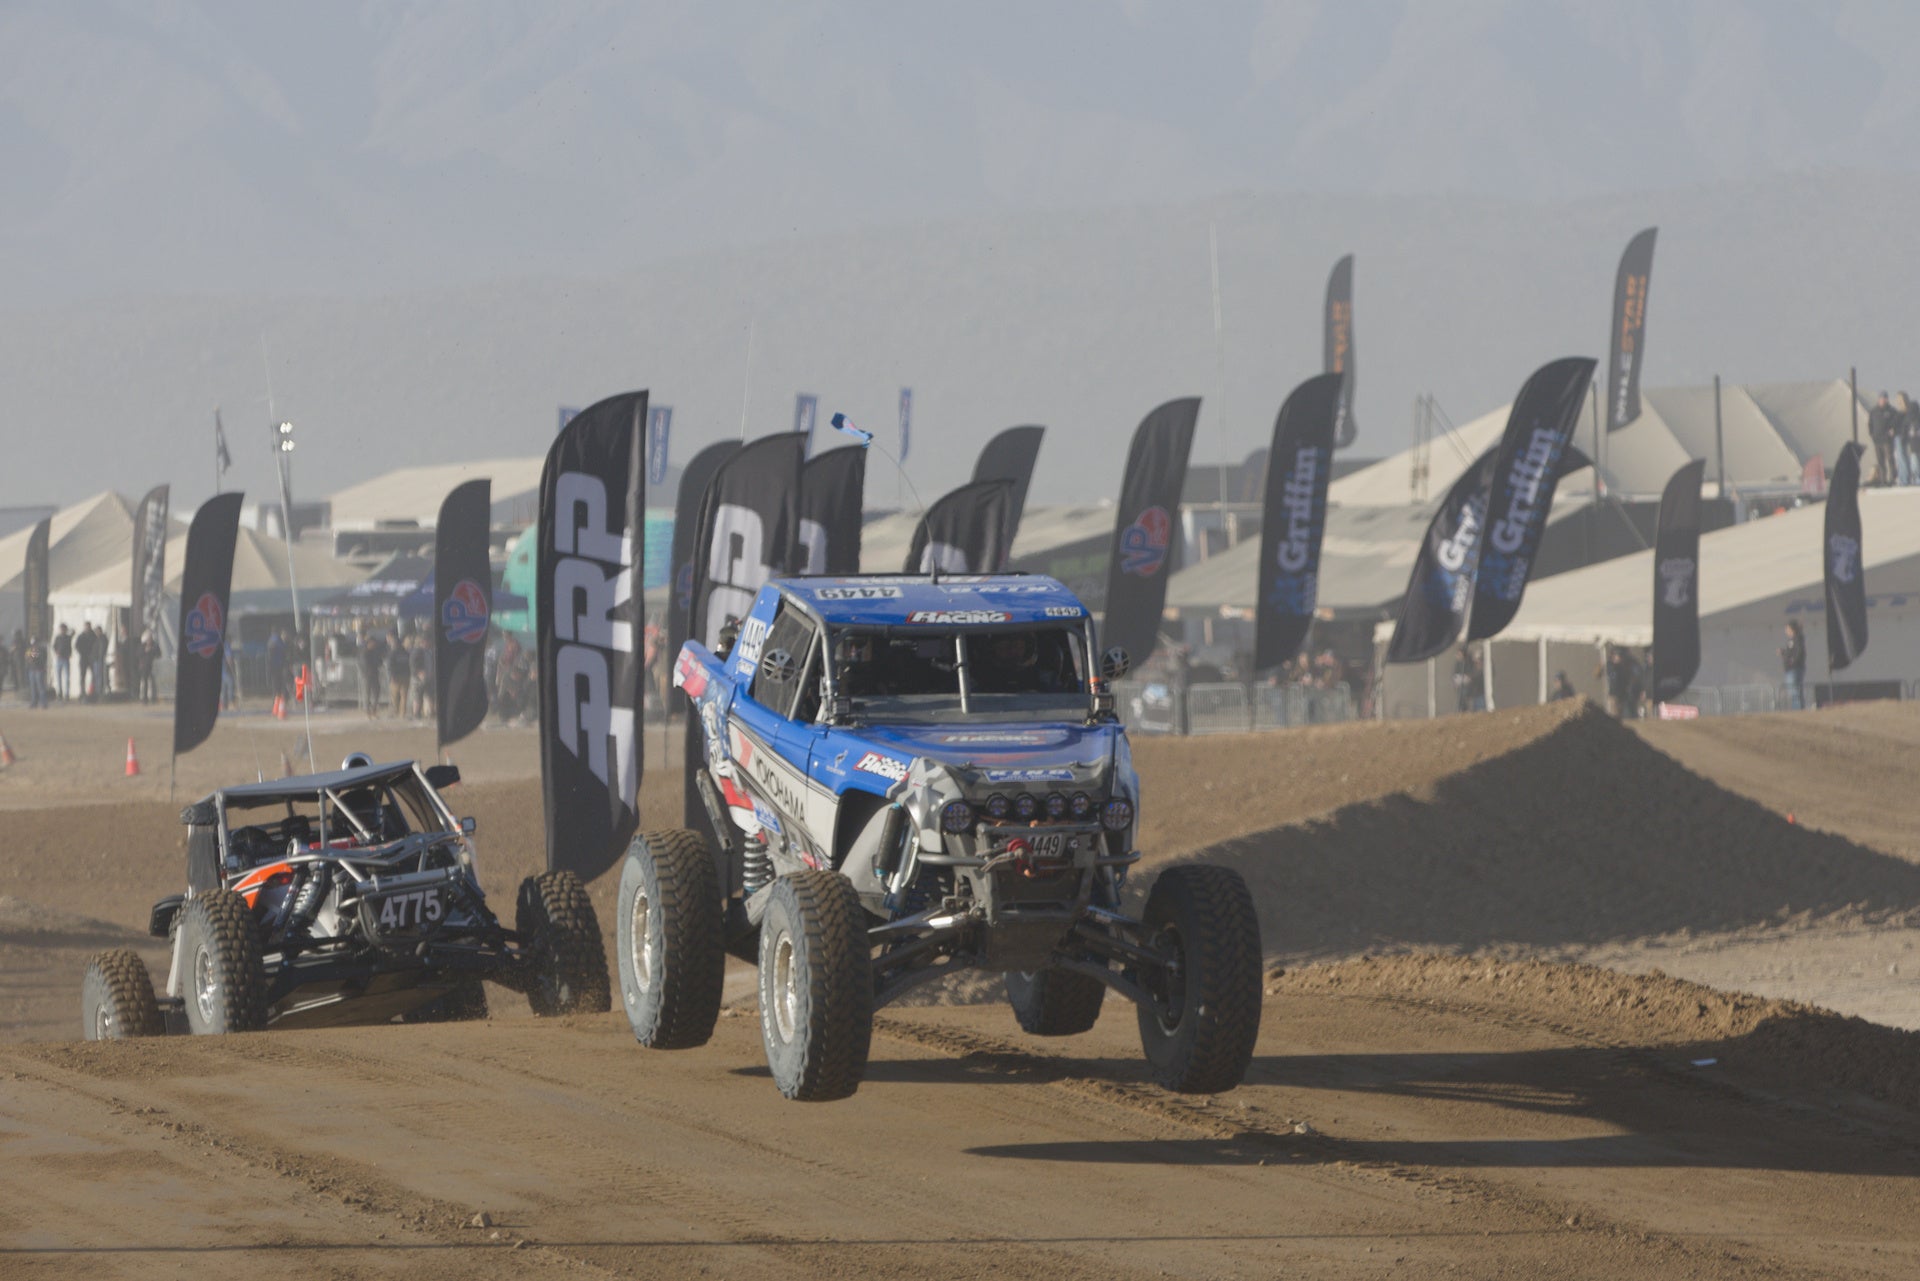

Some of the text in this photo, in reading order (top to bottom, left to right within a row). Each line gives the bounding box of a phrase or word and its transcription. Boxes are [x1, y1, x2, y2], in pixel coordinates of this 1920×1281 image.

[1278, 446, 1318, 572] Griffin
[1491, 426, 1558, 552] Griffin
[911, 611, 1008, 624] RACING
[1045, 606, 1081, 617] 4449
[554, 472, 634, 814] PRP
[754, 756, 806, 828] YOKOHAMA
[857, 753, 906, 782] RACING
[380, 888, 442, 929] 4775
